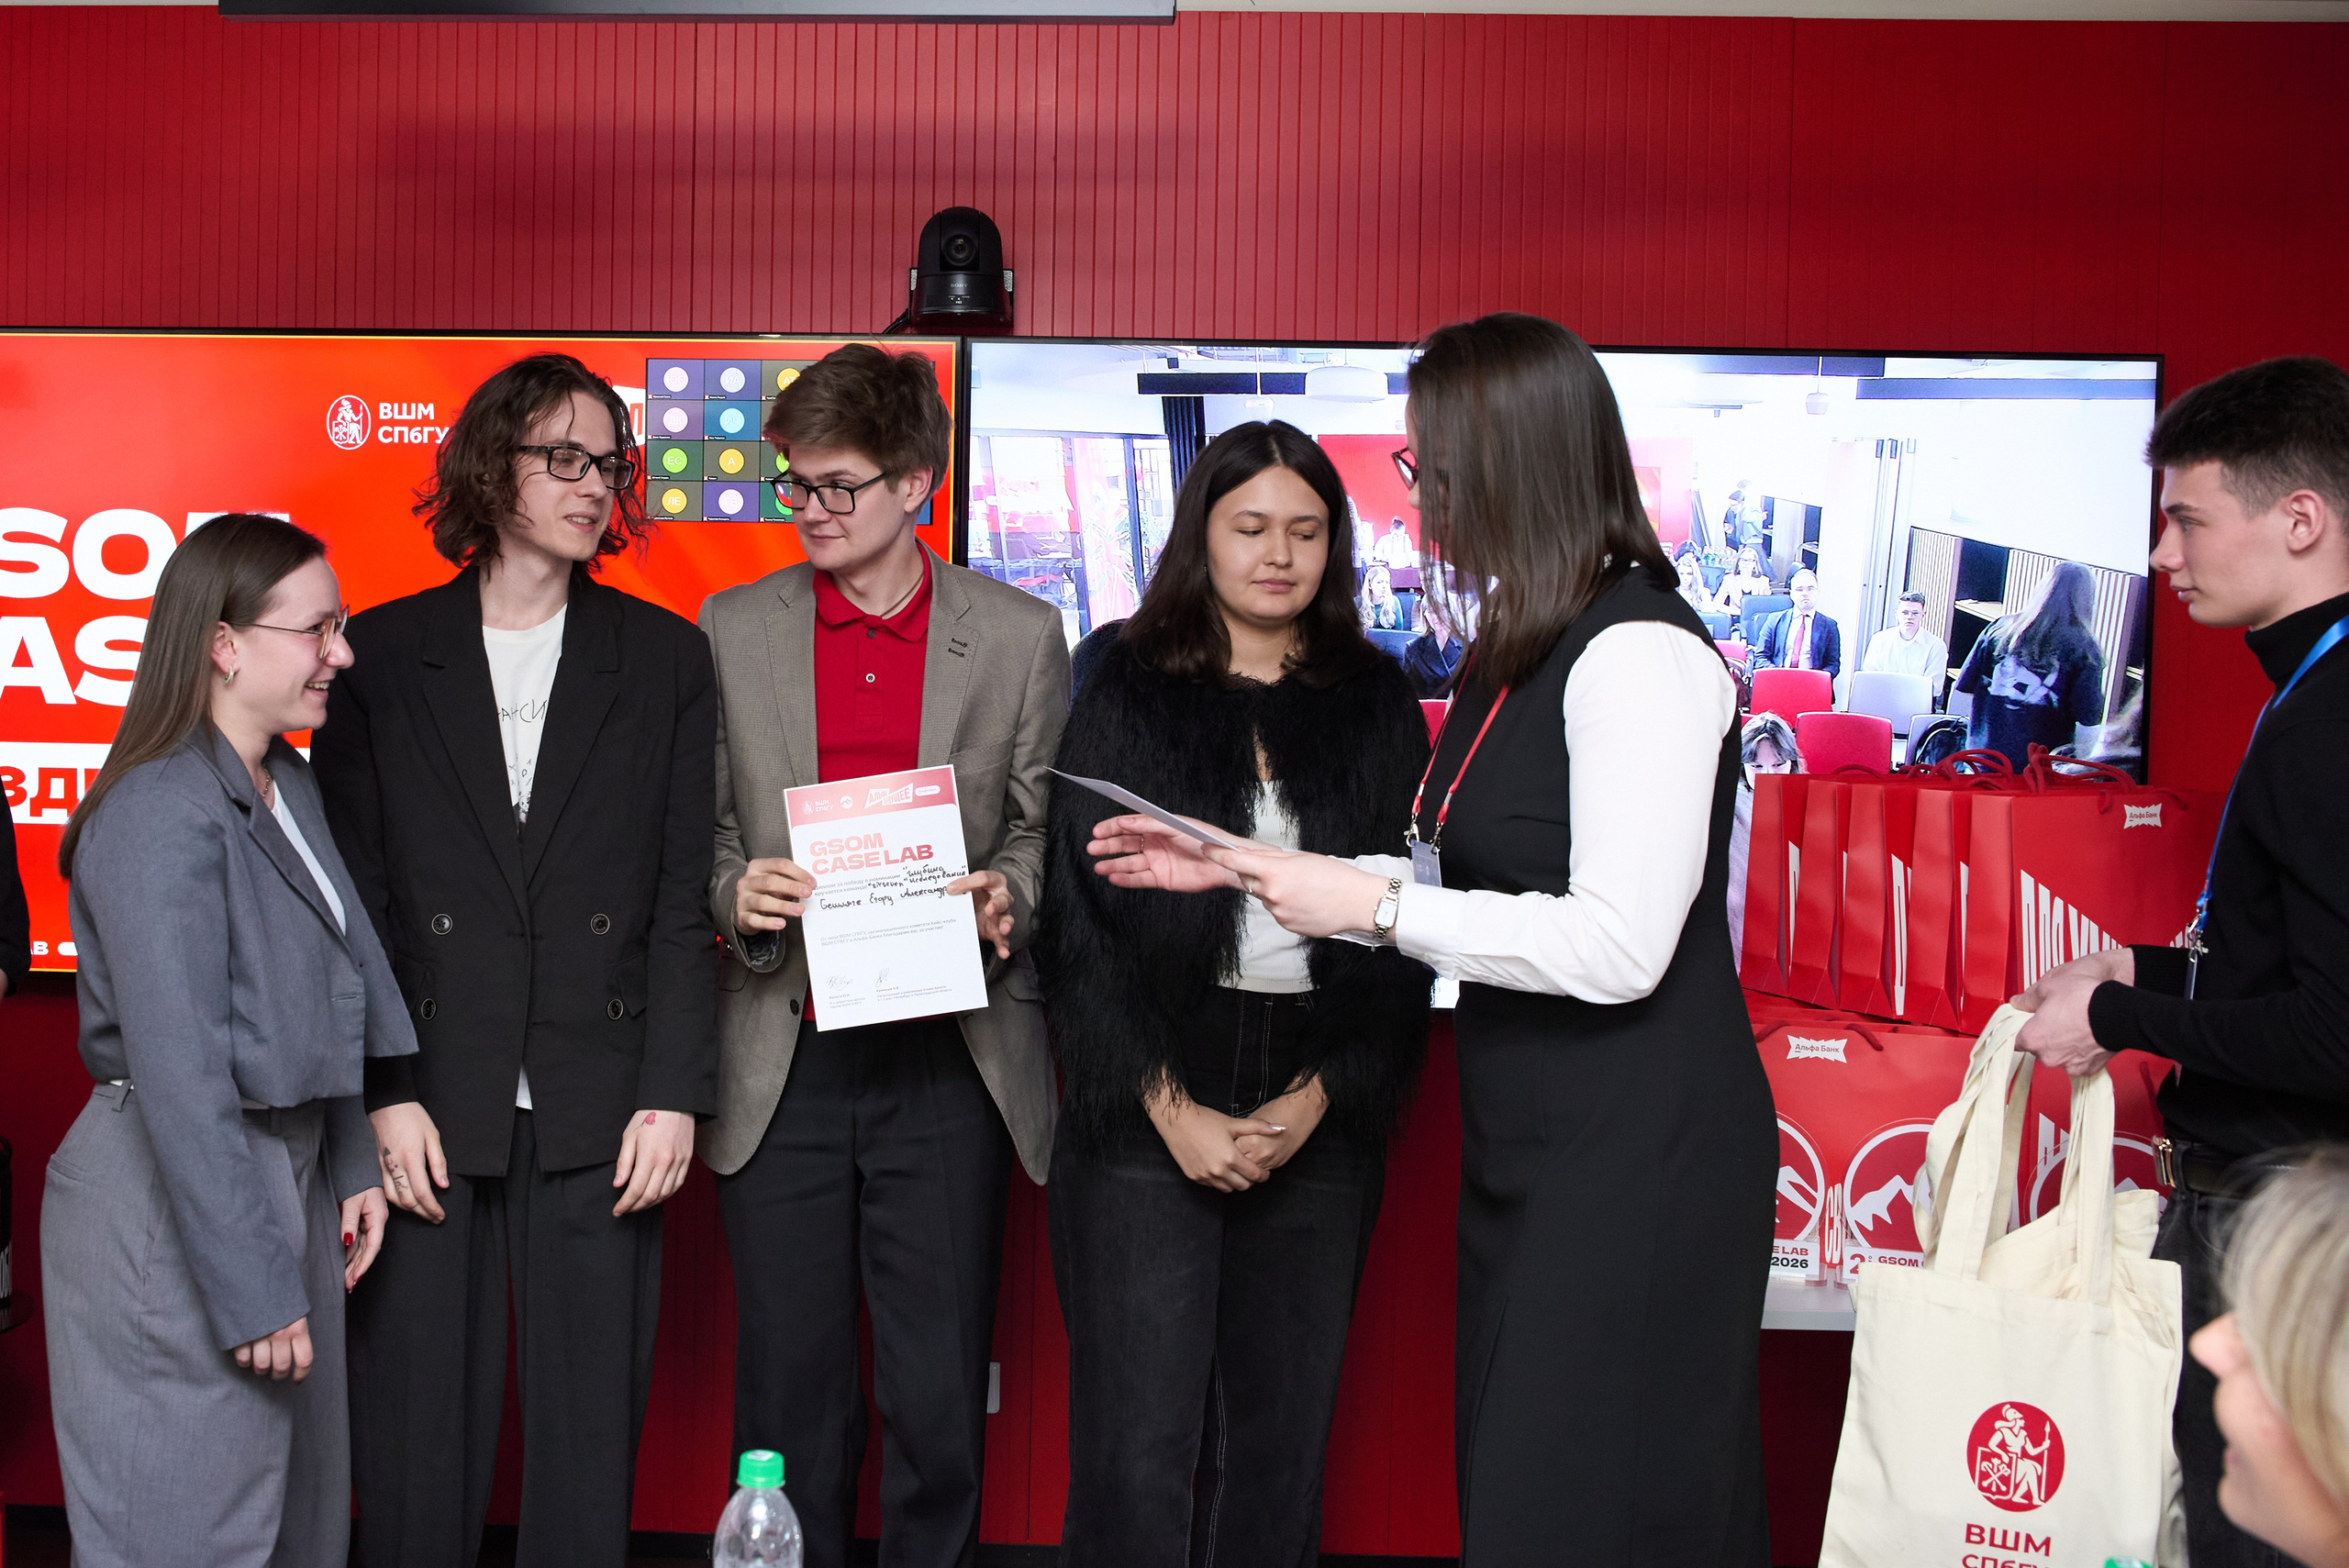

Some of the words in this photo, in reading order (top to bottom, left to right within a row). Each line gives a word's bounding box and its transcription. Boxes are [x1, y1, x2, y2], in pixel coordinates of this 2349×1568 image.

[379, 402, 435, 420] ВШМ
[809, 832, 885, 857] GSOM
[812, 851, 882, 875] CASE
[884, 844, 934, 865] LAB
[1795, 1043, 1820, 1052] Альфа
[1820, 1044, 1840, 1052] Банк
[1782, 1246, 1809, 1256] LAB
[1771, 1256, 1809, 1269] 2026
[1878, 1255, 1920, 1267] GSOM
[1965, 1522, 2052, 1557] ВШМ
